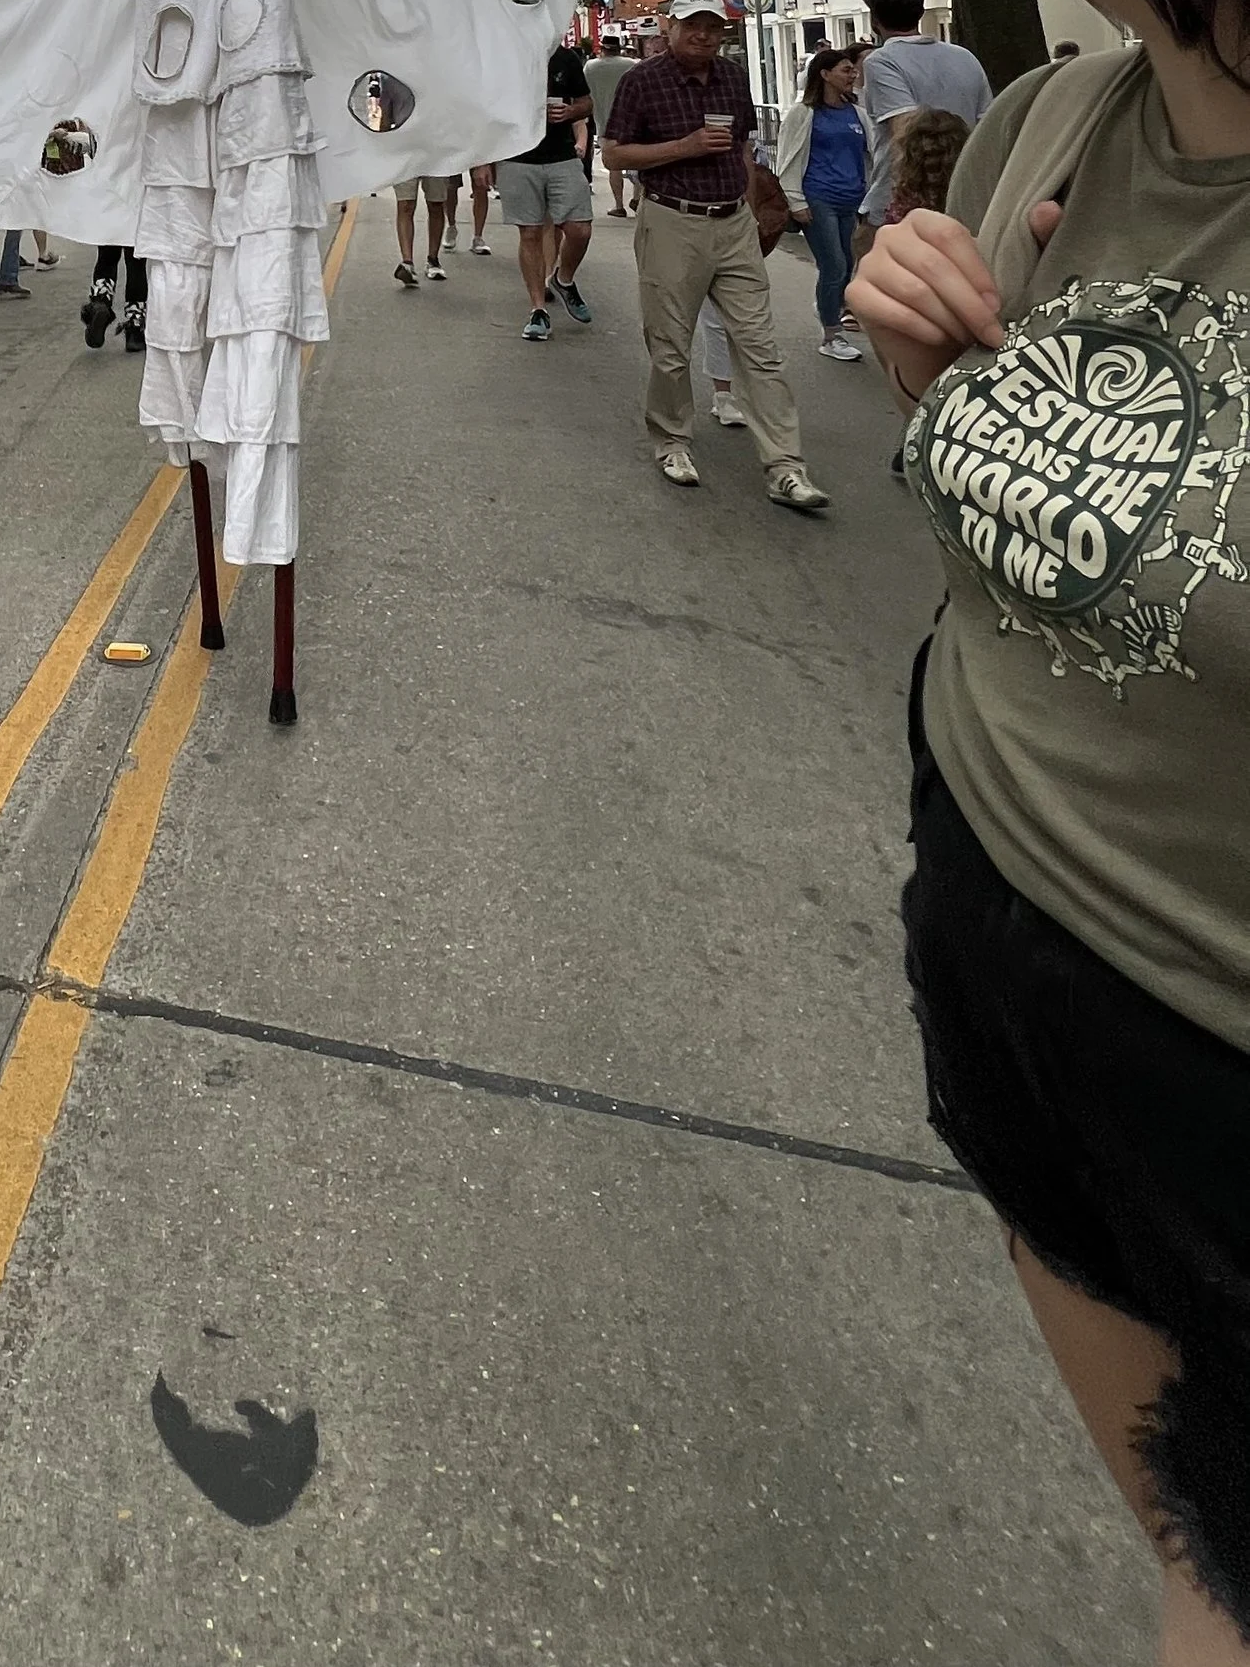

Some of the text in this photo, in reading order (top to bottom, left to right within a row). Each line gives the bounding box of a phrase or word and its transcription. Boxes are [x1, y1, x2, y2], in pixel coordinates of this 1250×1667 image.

[934, 384, 1171, 535] MEANS THE
[976, 347, 1183, 463] FESTIVAL
[930, 439, 1108, 579] WORLD
[959, 505, 1064, 598] TO ME
